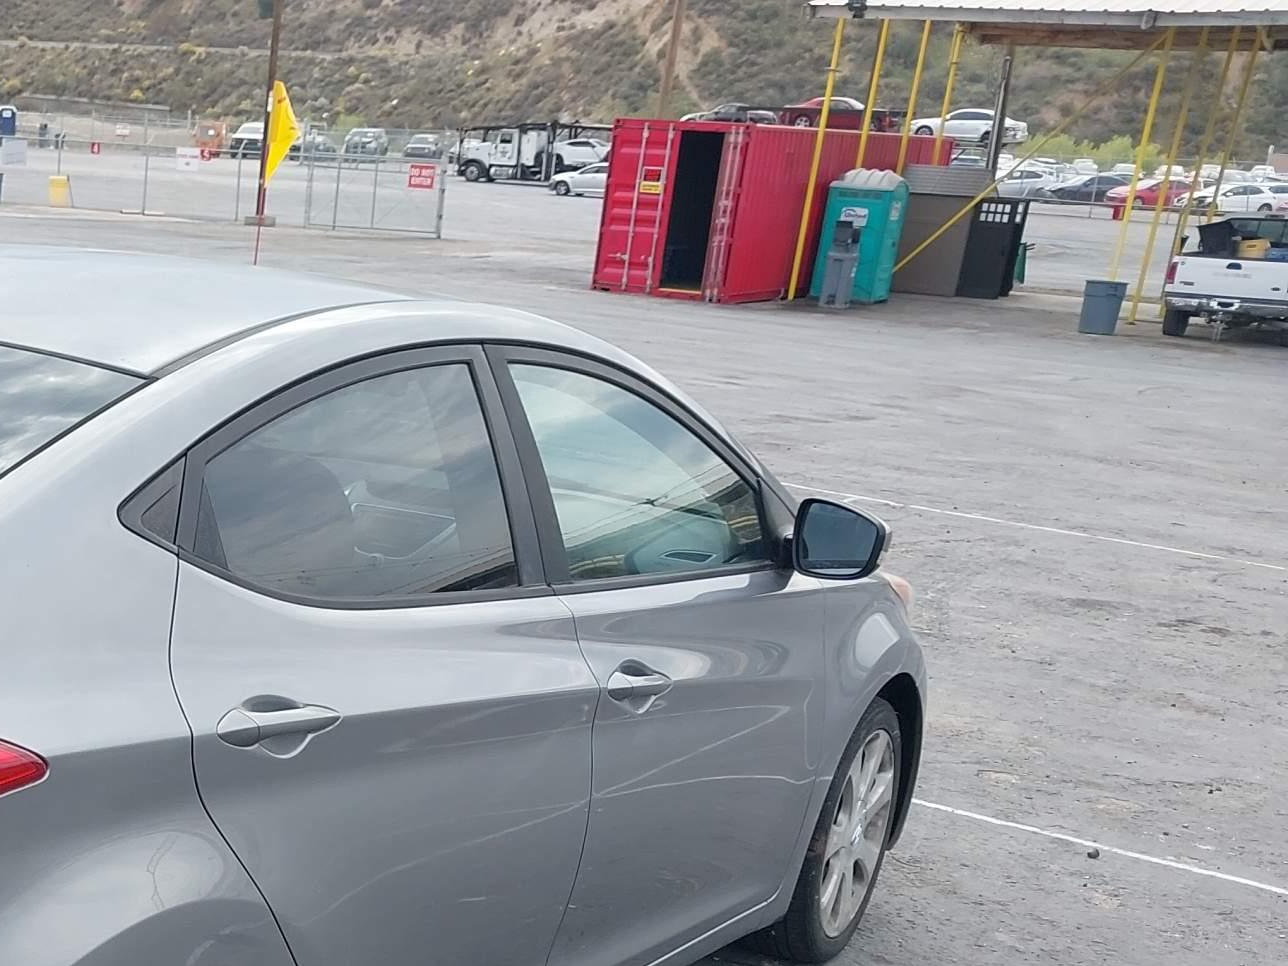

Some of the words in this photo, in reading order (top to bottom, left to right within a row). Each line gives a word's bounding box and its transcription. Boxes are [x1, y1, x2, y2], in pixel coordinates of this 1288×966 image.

[411, 167, 421, 176] DO
[422, 168, 435, 177] NOT
[410, 177, 431, 185] ENTER
